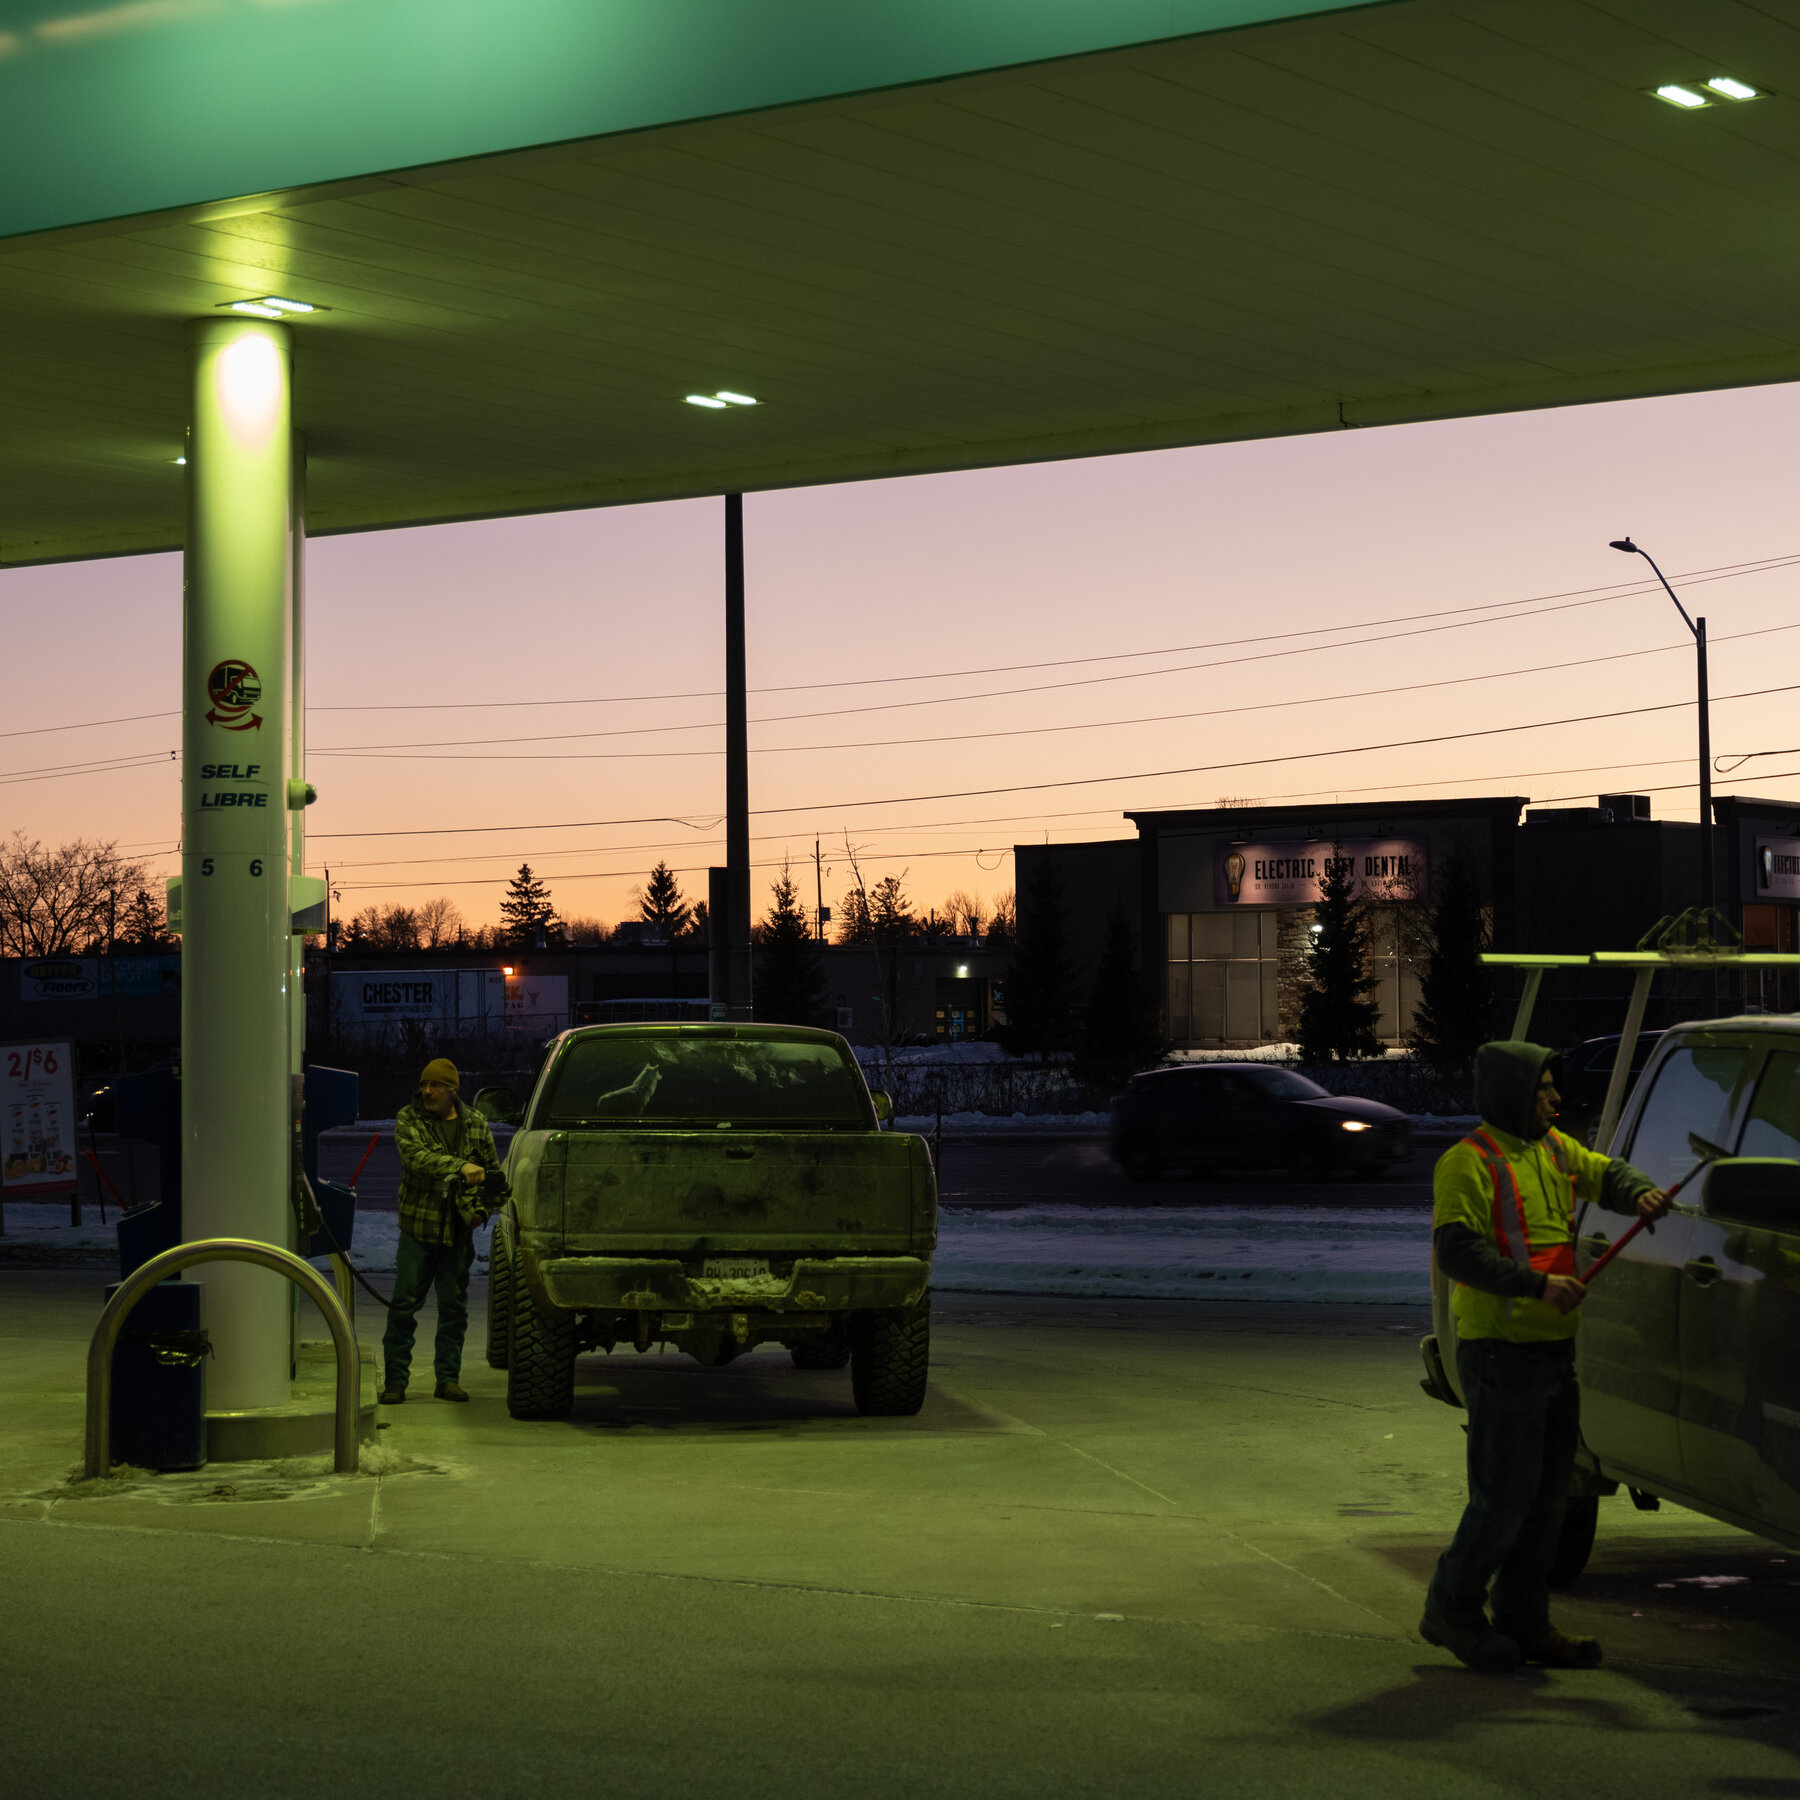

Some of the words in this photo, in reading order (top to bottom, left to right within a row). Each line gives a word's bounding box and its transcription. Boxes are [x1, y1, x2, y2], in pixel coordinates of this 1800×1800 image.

[200, 764, 261, 779] SELF
[201, 792, 268, 807] LIBRE
[201, 858, 214, 876] 5
[249, 859, 263, 877] 6
[1255, 858, 1315, 880] ELECTRIC
[1324, 857, 1355, 878] CTY
[1365, 855, 1411, 877] DENTAL
[101, 959, 160, 973] KTCHENS
[363, 982, 433, 1004] CHESTER
[8, 1047, 59, 1082] 2/$6
